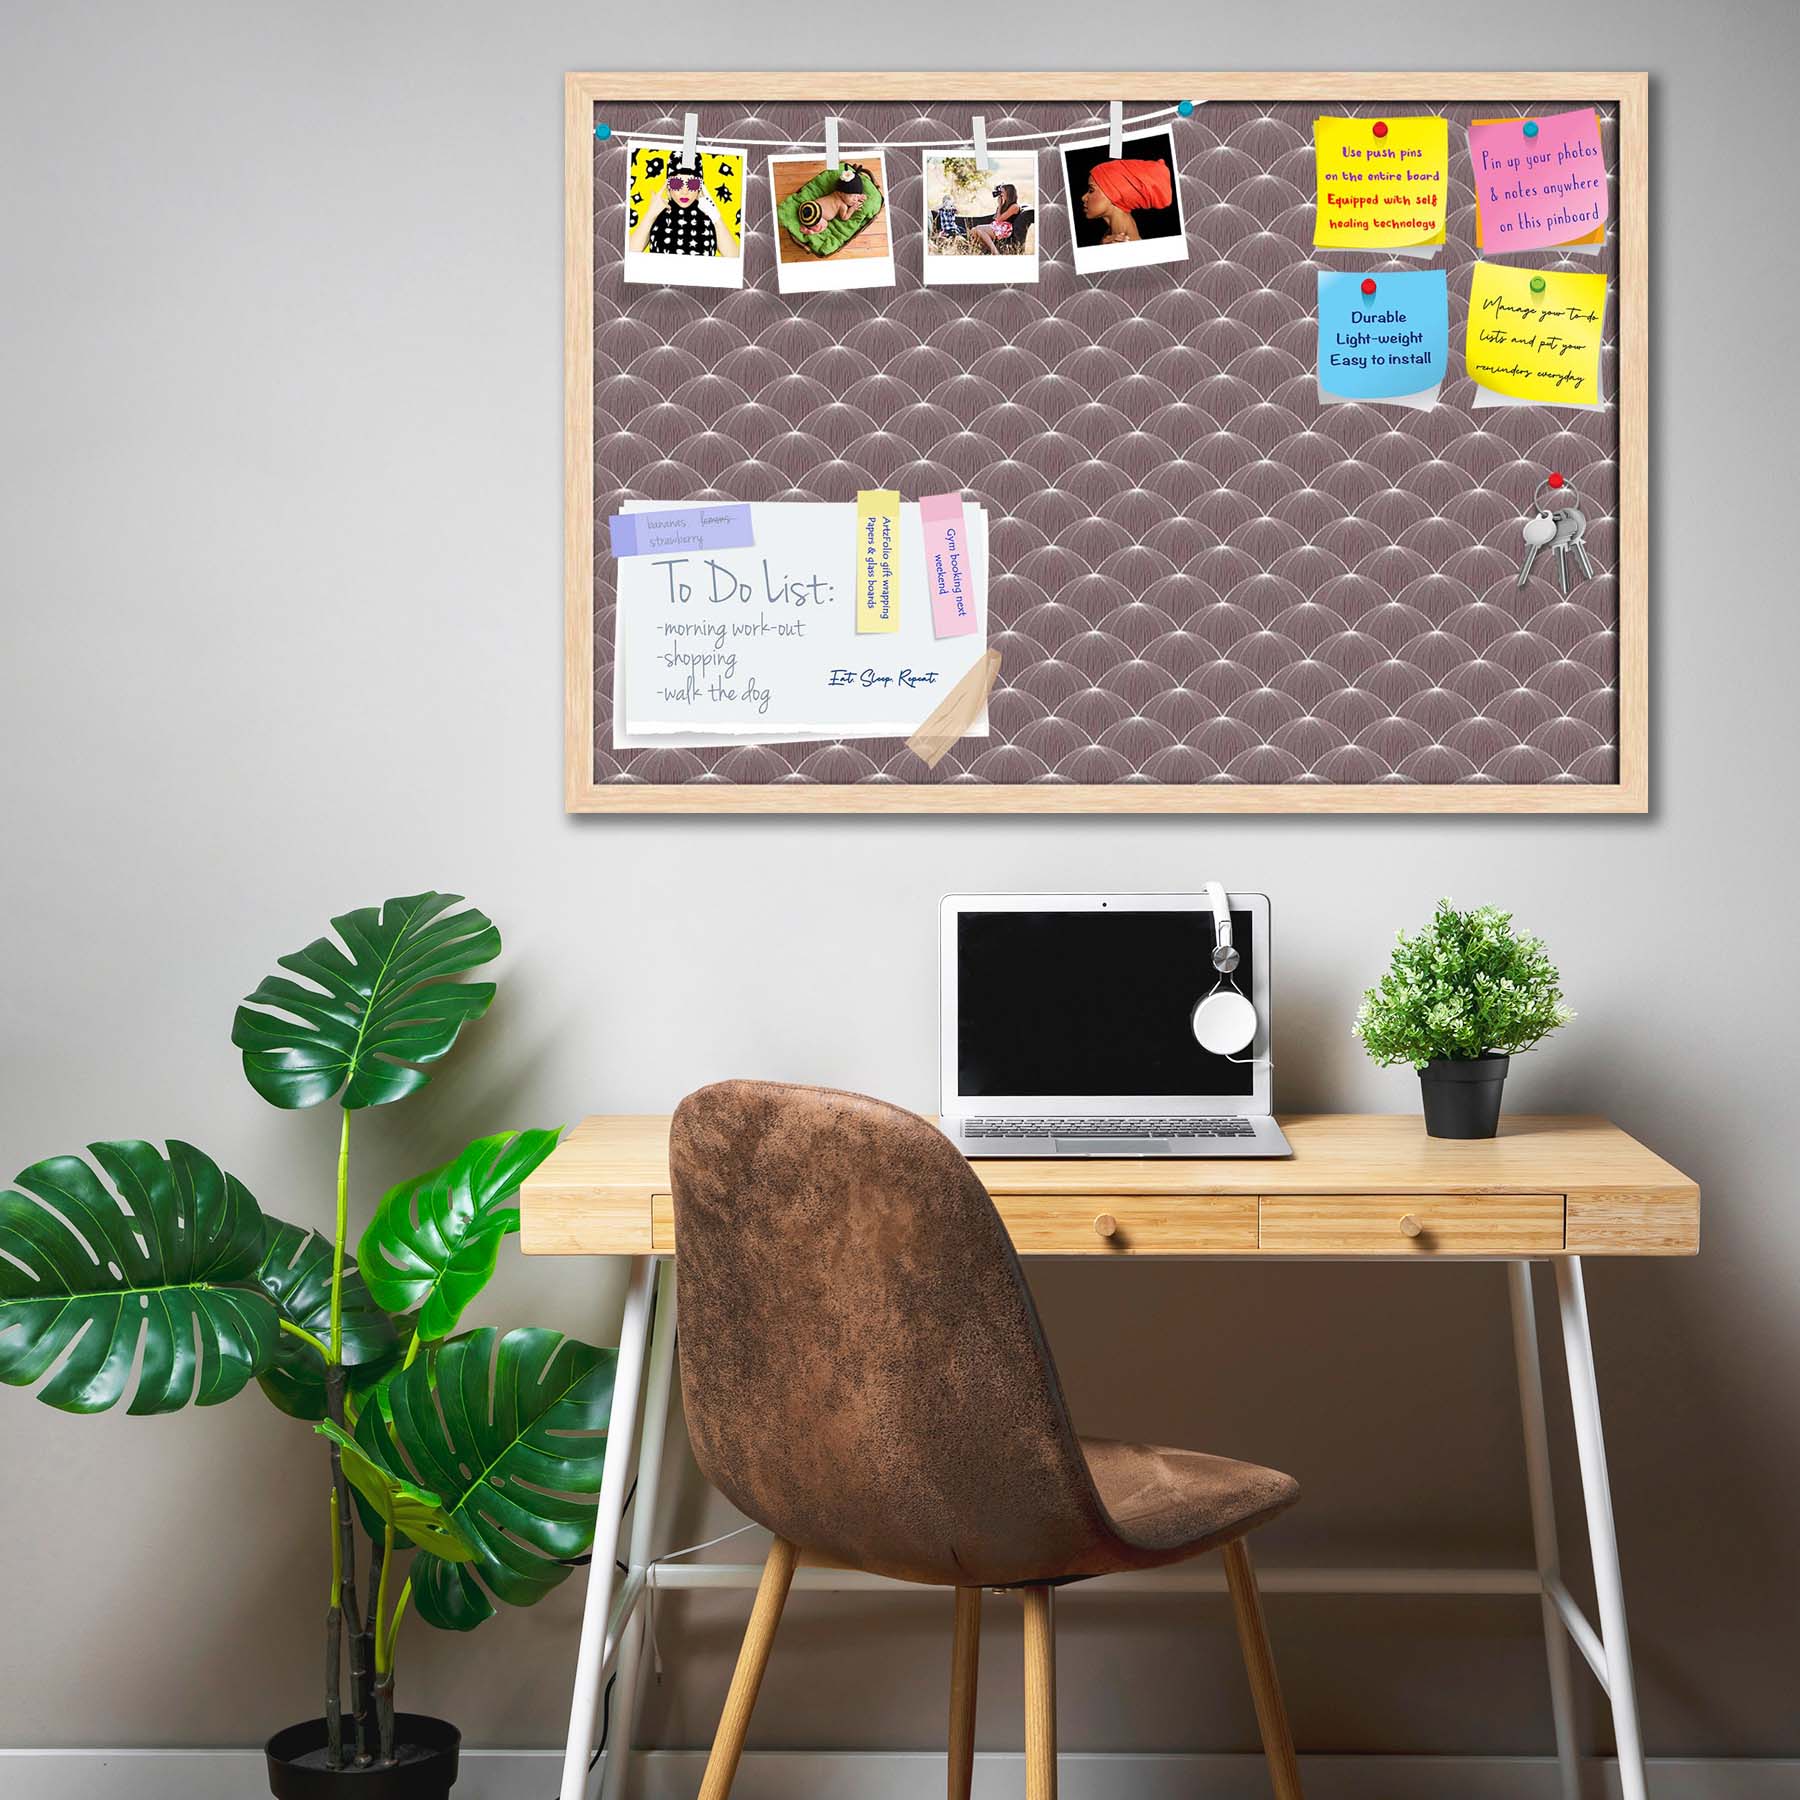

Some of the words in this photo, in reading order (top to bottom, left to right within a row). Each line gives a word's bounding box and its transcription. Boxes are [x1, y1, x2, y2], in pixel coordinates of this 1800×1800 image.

[1342, 146, 1362, 158] Use
[1366, 148, 1396, 161] push
[1400, 148, 1423, 161] pins
[1482, 150, 1502, 171] Pin
[1507, 157, 1521, 172] up
[1526, 153, 1552, 170] your
[1558, 140, 1598, 166] photos
[1325, 173, 1338, 181] on
[1342, 171, 1363, 182] the
[1367, 171, 1402, 181] entire
[1407, 170, 1440, 181] board
[1490, 186, 1498, 202] &
[1504, 181, 1538, 200] notes
[1543, 173, 1599, 198] anywhere
[1327, 193, 1379, 208] Equipped
[1384, 195, 1411, 206] with
[1416, 194, 1438, 207] self
[1329, 218, 1369, 231] healing
[1373, 218, 1436, 231] technology
[1500, 222, 1513, 232] on
[1518, 212, 1541, 230] this
[1547, 202, 1599, 231] pinboard
[1351, 310, 1407, 324] Durable
[1482, 295, 1537, 320] Manage
[1539, 309, 1566, 323] your
[1336, 331, 1423, 348] Light-weight
[1511, 335, 1537, 348] and
[1537, 336, 1563, 353] put
[1559, 343, 1586, 356] your
[1330, 353, 1367, 369] Easy
[1371, 354, 1385, 365] to
[1388, 351, 1432, 365] install
[1475, 364, 1533, 378] reminders
[1536, 370, 1585, 389] everyday
[649, 529, 704, 550] strawberry
[866, 517, 877, 545] Papers
[882, 516, 892, 560] ArtzFolio
[945, 528, 956, 551] Gym
[867, 546, 876, 554] &
[865, 557, 877, 578] glass
[880, 561, 893, 577] gift
[935, 554, 949, 595] weekend
[950, 554, 963, 594] booking
[651, 558, 692, 604] To
[704, 559, 752, 604] Do
[763, 558, 834, 607] List:
[867, 580, 877, 609] boards
[880, 580, 891, 619] wrapping
[955, 596, 967, 617] next
[656, 619, 727, 650] -morning
[732, 611, 807, 637] work-out
[656, 639, 738, 679] -shopping
[656, 674, 703, 705] -walk
[708, 674, 738, 702] the
[741, 677, 772, 714] dog
